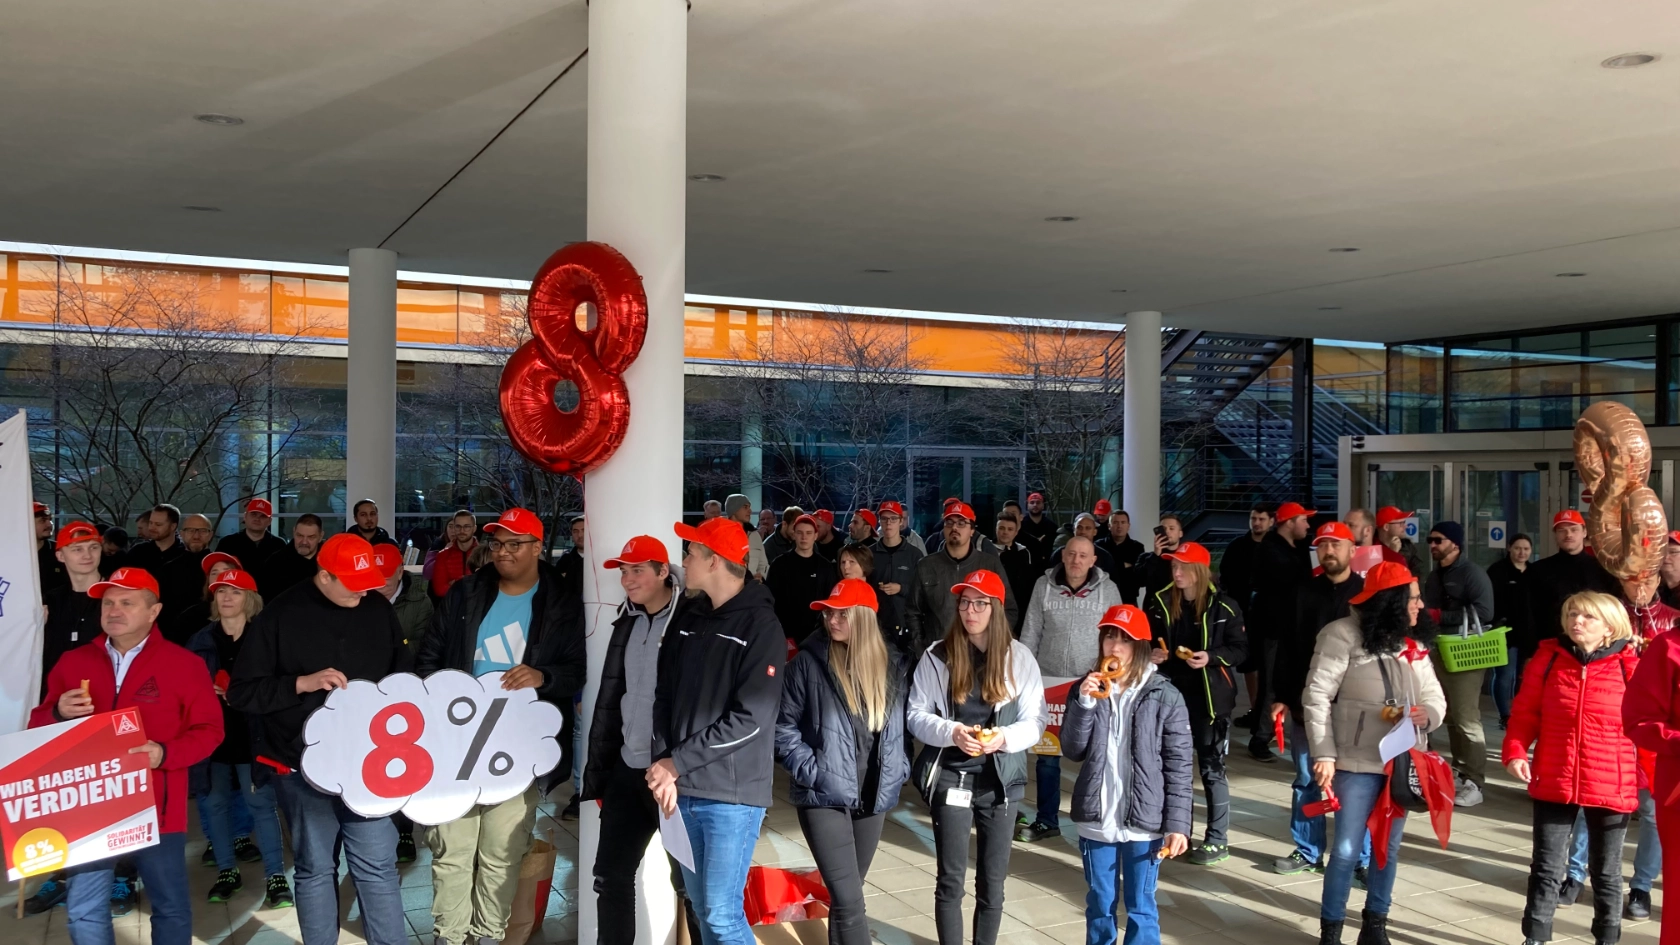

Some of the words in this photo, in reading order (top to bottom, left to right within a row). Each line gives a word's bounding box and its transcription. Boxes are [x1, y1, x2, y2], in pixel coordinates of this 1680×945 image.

[1045, 600, 1103, 612] HOLLISTER
[1047, 703, 1066, 712] HAB
[362, 695, 514, 799] 8%
[0, 778, 35, 800] WIR
[38, 763, 97, 791] HABEN
[100, 757, 121, 777] ES
[3, 768, 148, 824] VERDIENT!
[107, 824, 146, 839] SOLIDARITÄT
[24, 839, 55, 859] 8%
